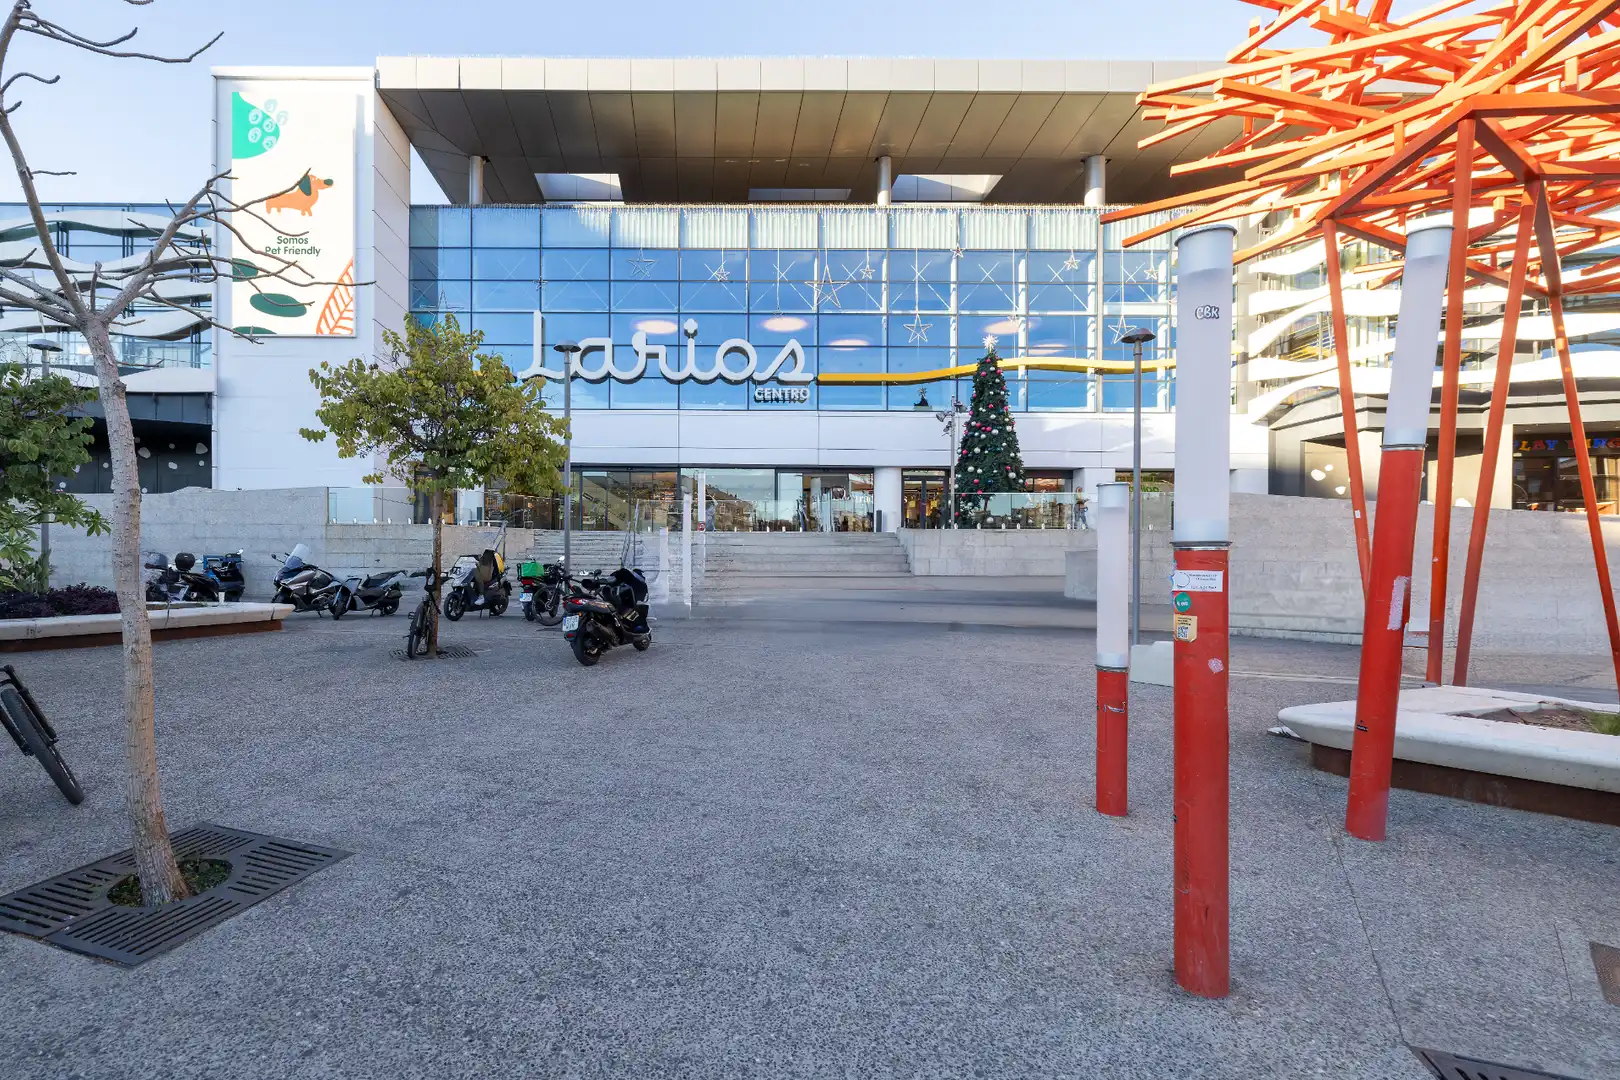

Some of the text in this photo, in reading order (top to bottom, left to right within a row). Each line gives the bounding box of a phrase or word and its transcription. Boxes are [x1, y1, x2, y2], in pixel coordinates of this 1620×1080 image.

[276, 235, 309, 245] Somos
[264, 246, 321, 257] Pet Friendly
[754, 387, 810, 402] CENTRO
